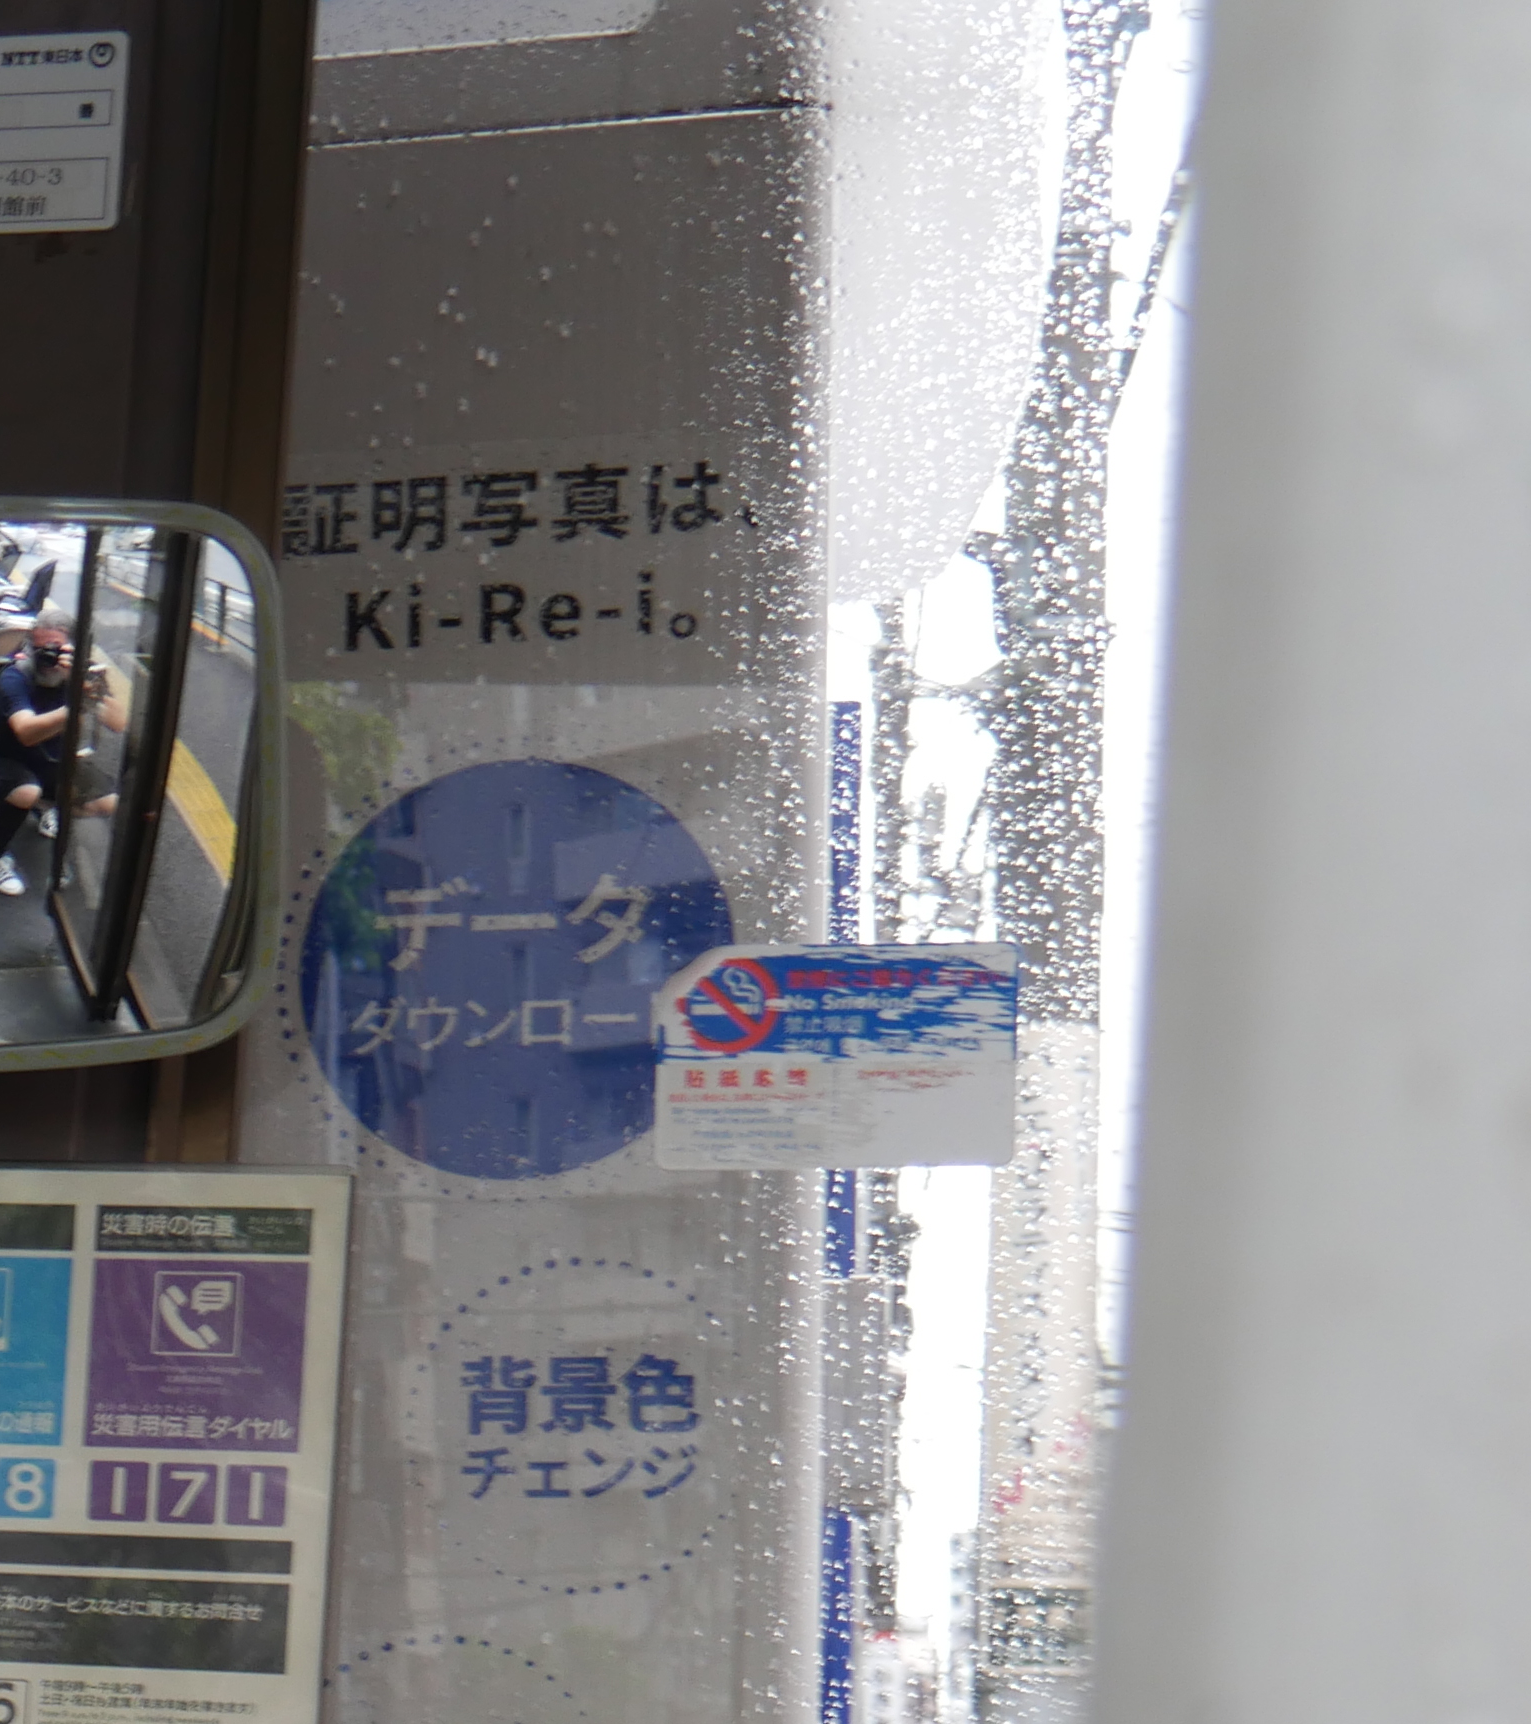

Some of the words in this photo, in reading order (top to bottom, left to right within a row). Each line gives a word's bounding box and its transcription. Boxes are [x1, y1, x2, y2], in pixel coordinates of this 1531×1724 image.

[1, 48, 84, 66] NTT東日本
[374, 872, 652, 971] データ
[350, 994, 639, 1056] ダウンロー
[100, 1212, 235, 1238] 災害時の伝言
[459, 1352, 703, 1436] 背景色
[91, 1413, 295, 1440] 災害用伝言ダイヤル
[109, 1466, 264, 1520] 171
[459, 1443, 700, 1501] チェンジ
